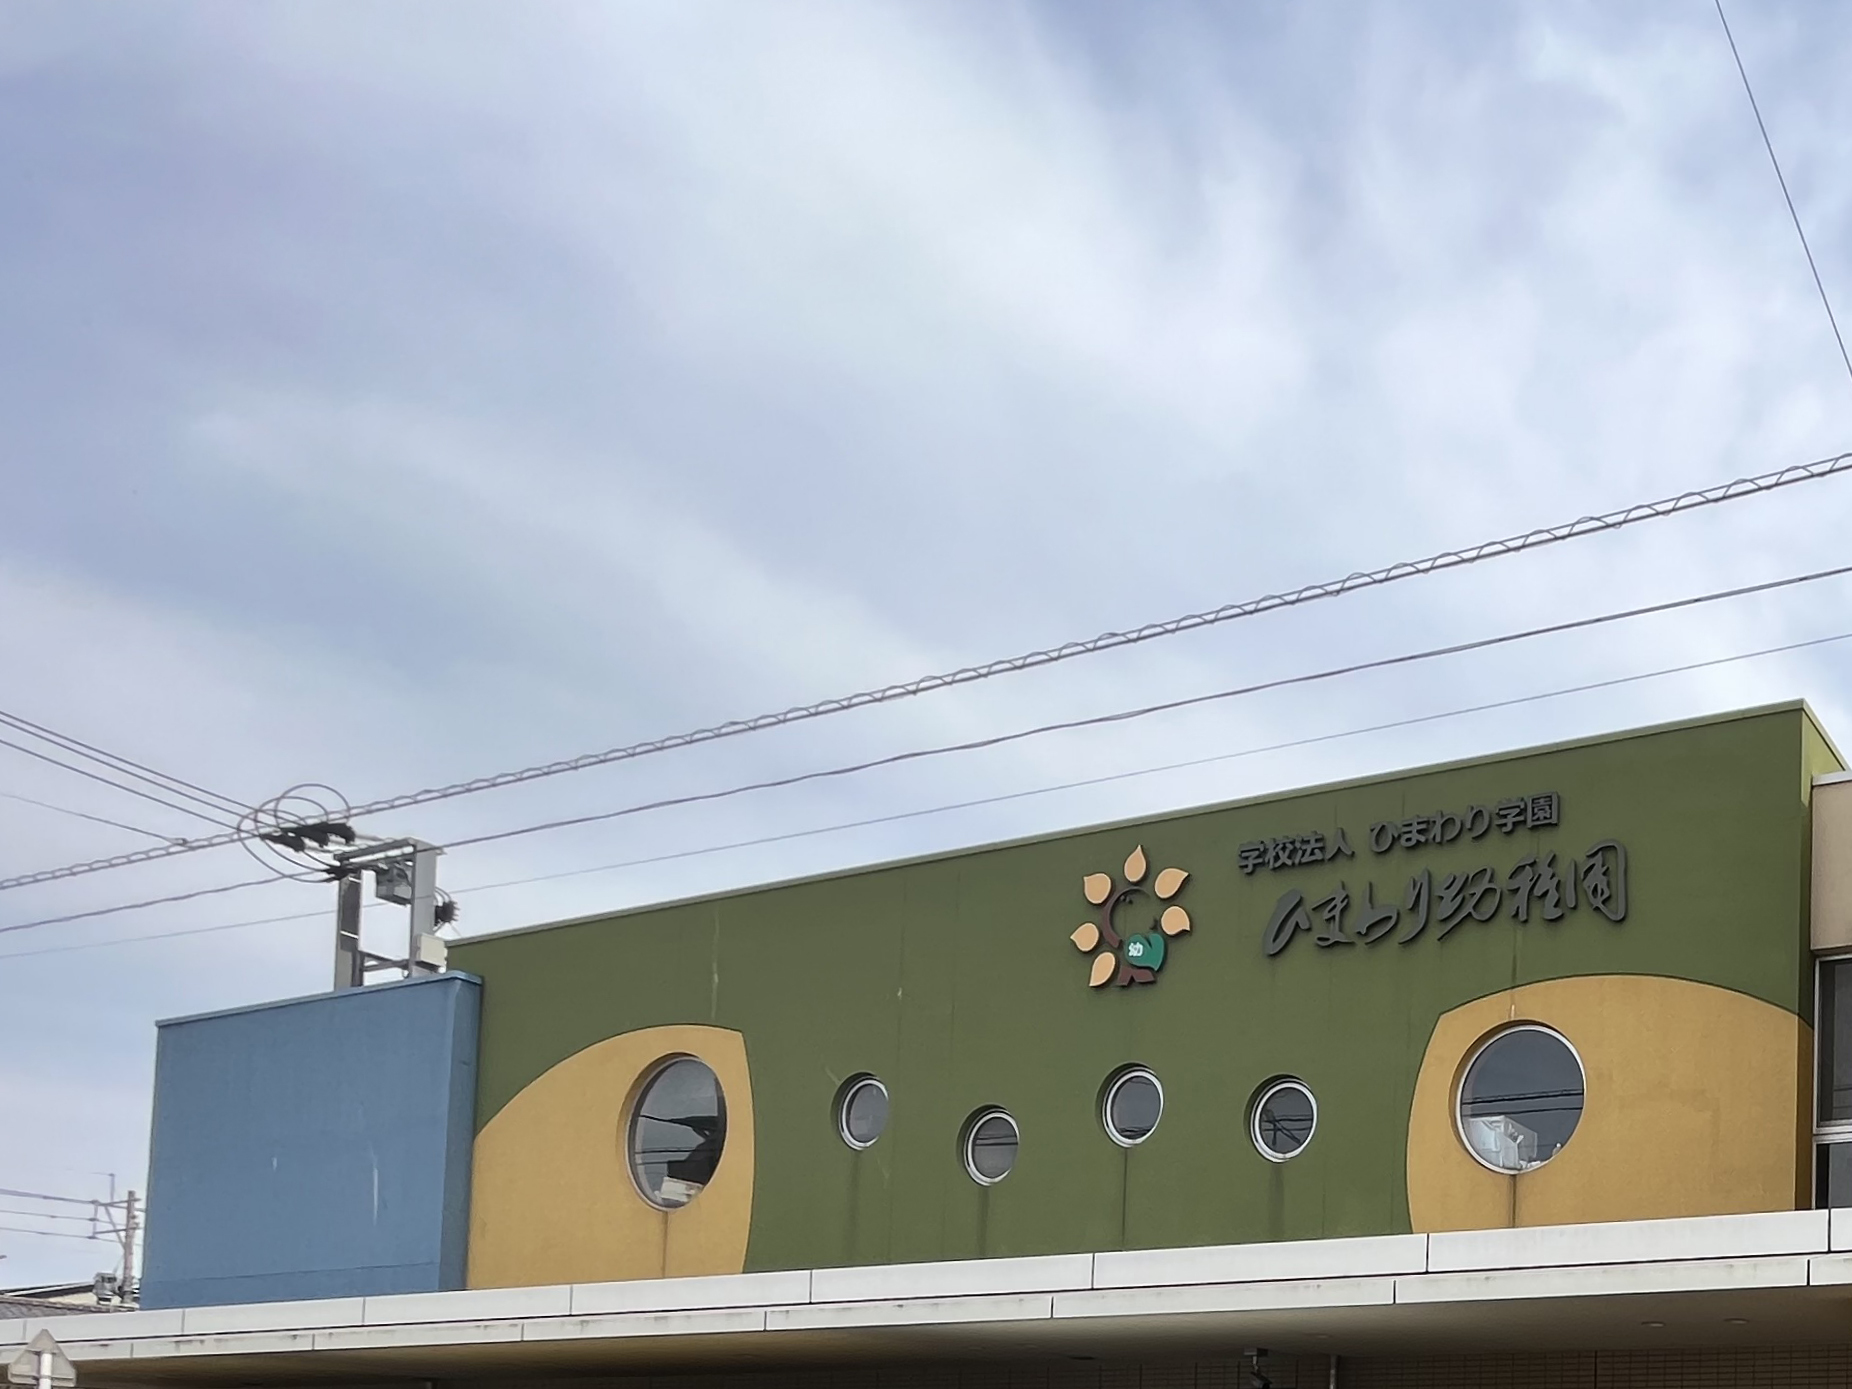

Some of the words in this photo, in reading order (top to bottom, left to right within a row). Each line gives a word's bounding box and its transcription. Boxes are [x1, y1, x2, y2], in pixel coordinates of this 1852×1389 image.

[1237, 827, 1354, 875] 学校法人
[1369, 791, 1561, 854] ひまわり学園
